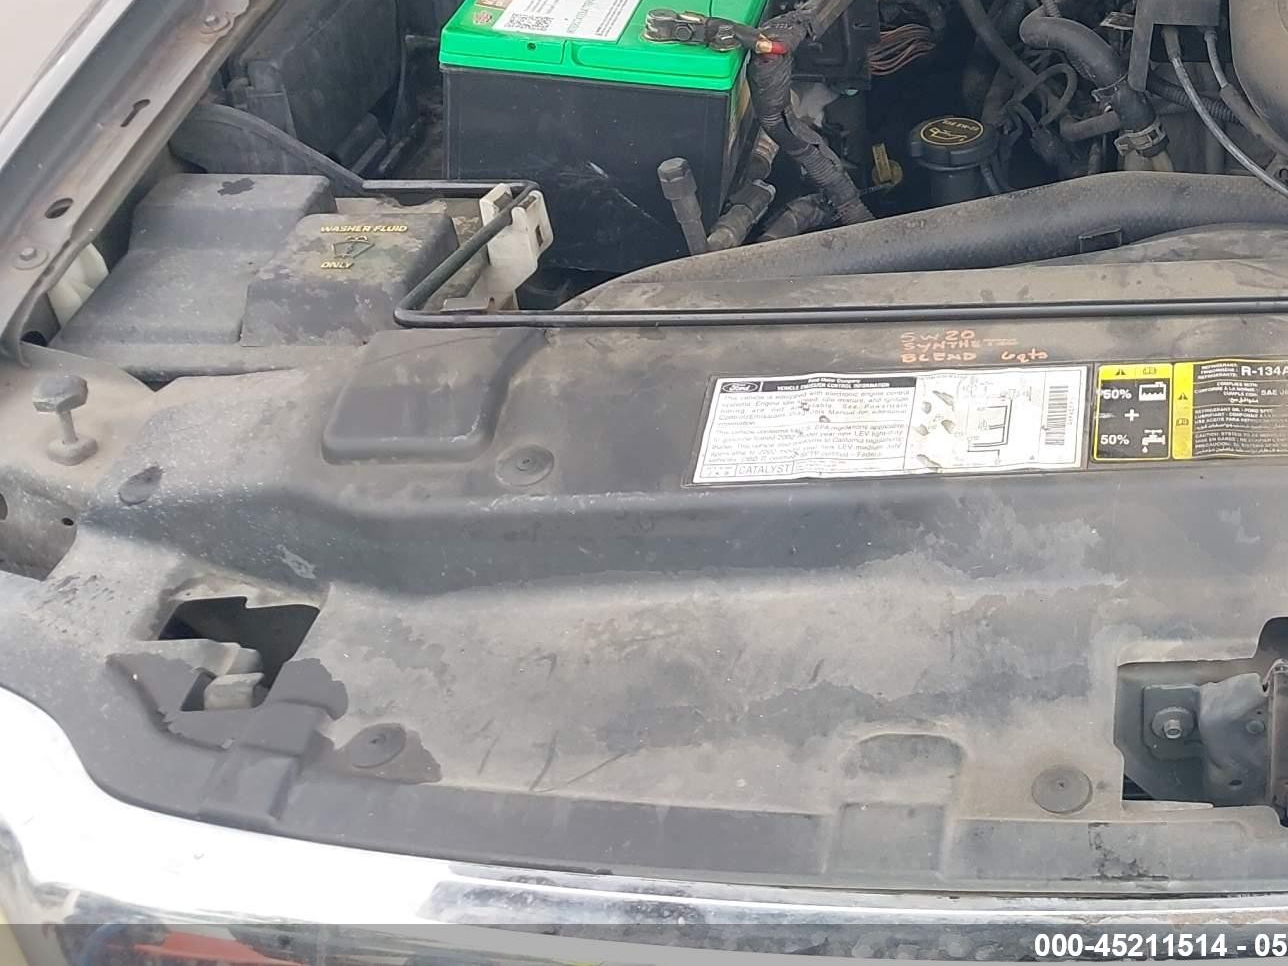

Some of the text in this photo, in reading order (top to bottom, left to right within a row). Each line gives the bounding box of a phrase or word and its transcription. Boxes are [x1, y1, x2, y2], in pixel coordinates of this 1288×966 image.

[901, 352, 977, 363] BLEND
[1103, 389, 1132, 399] 50%
[1100, 434, 1130, 445] 50%
[738, 464, 789, 474] CATALYST
